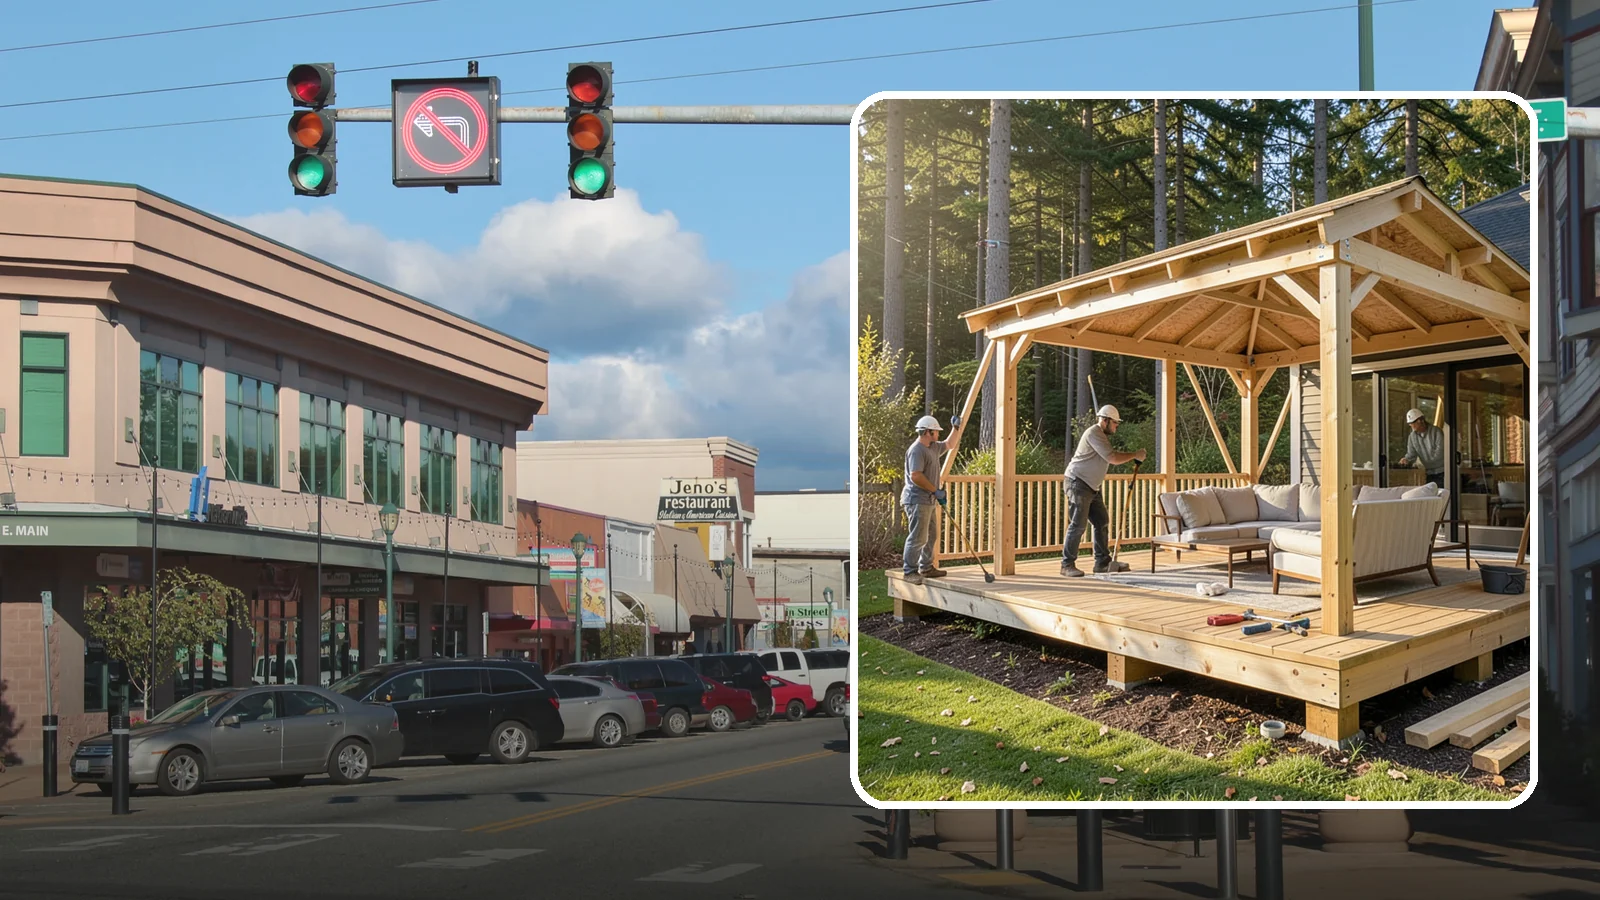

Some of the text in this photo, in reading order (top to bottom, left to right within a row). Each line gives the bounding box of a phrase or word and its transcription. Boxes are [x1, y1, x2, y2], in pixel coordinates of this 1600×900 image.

[670, 480, 727, 495] Jeno's
[665, 496, 731, 509] restaurant
[659, 510, 681, 519] Italian
[685, 509, 714, 519] American
[715, 509, 738, 519] Cuisine
[2, 525, 49, 536] E. MAIN
[797, 608, 828, 617] Street
